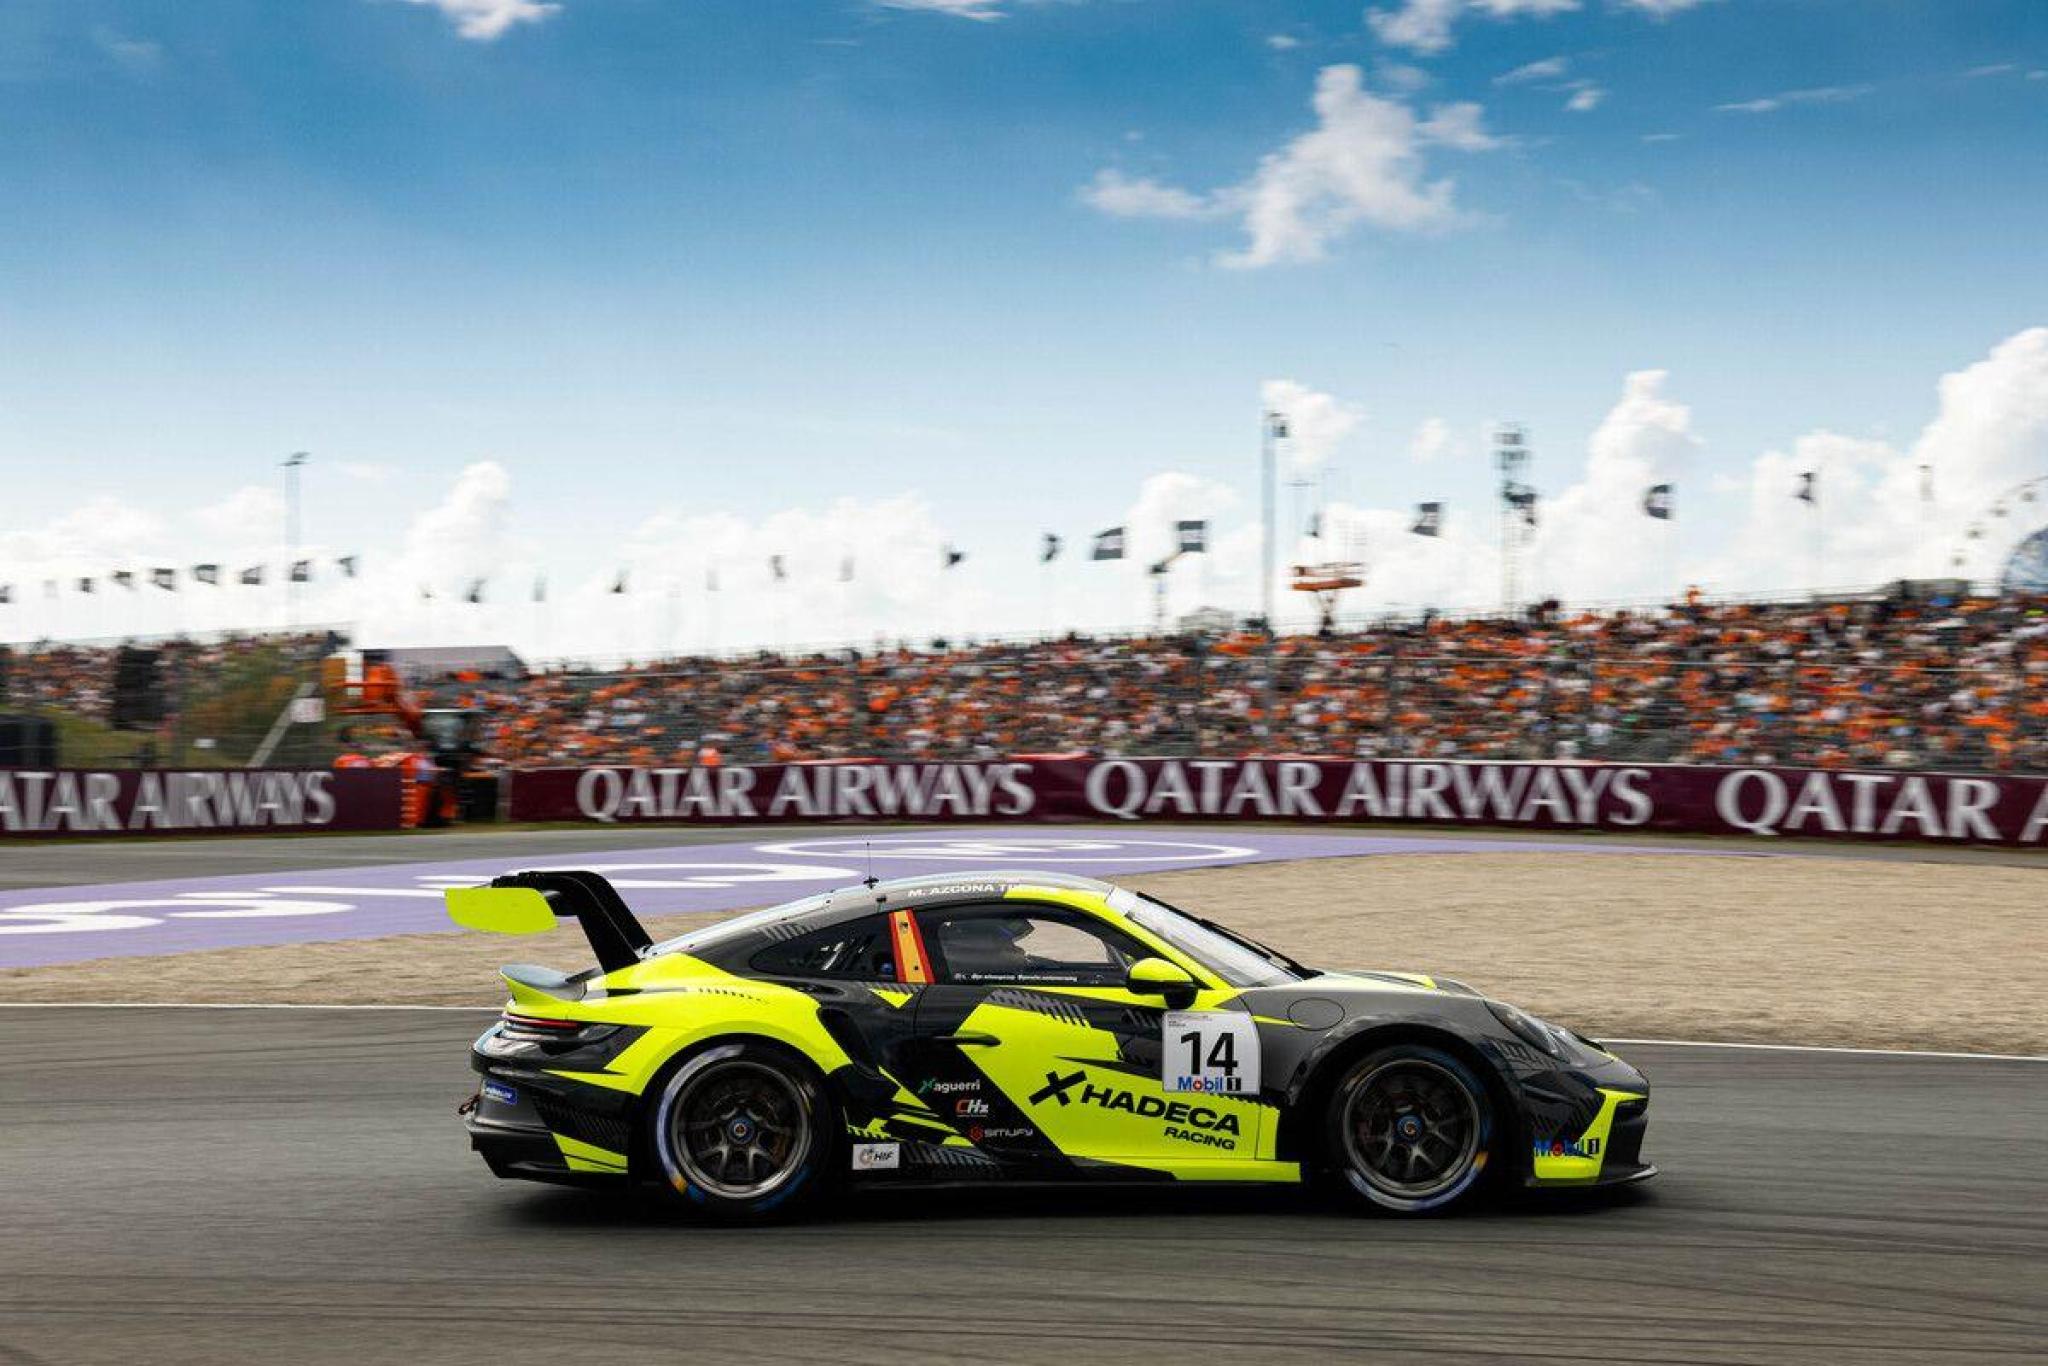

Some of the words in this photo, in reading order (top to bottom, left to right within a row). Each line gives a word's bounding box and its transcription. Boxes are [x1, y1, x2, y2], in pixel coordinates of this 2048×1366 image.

[128, 770, 336, 829] AIRWAYS
[576, 766, 760, 822] QATAR
[768, 763, 1035, 817] AIRWAYS
[1084, 760, 1324, 820] QATAR
[1335, 762, 1654, 826] AIRWAYS
[1715, 769, 2003, 841] QATAR
[929, 884, 994, 896] AZCONA
[1181, 1031, 1238, 1076] 14
[1178, 1076, 1223, 1091] Mobil
[1164, 1127, 1236, 1150] RACING
